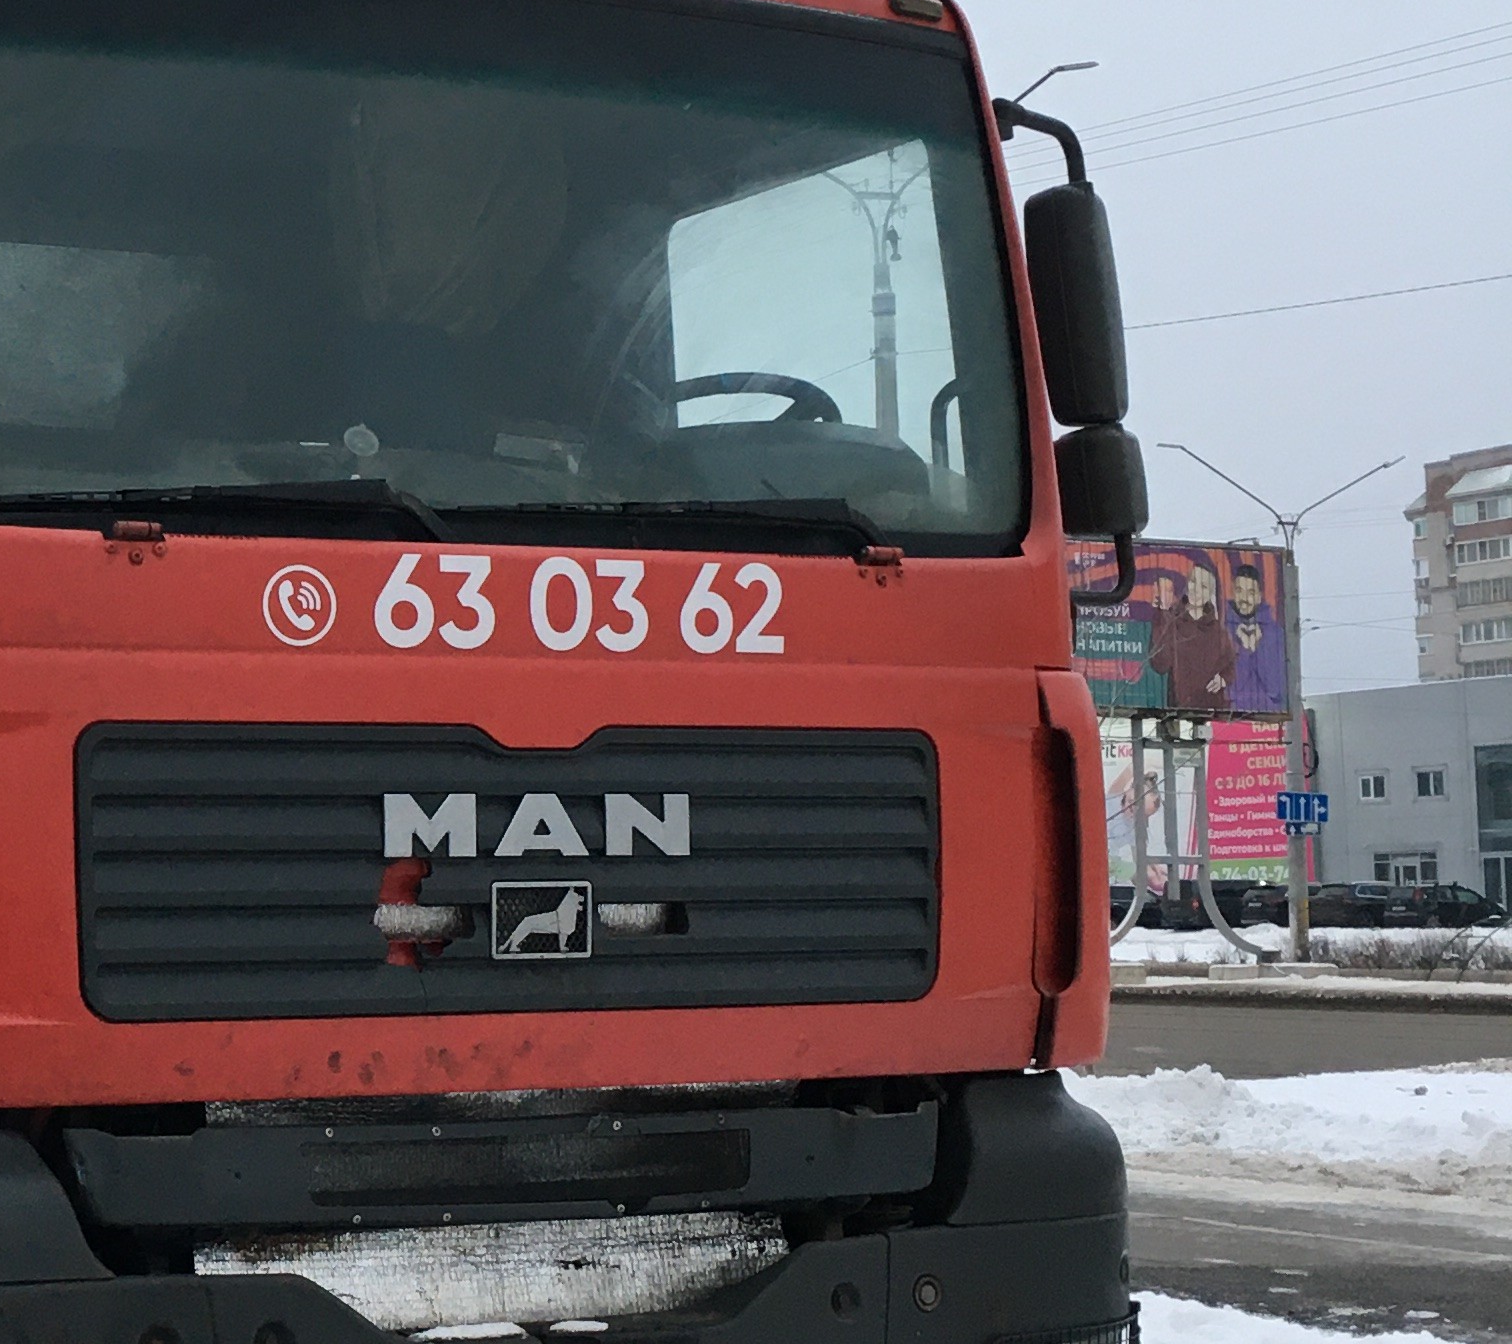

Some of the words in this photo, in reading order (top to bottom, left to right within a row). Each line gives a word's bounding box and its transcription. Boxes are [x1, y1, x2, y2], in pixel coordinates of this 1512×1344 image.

[374, 553, 496, 650] 63
[529, 556, 649, 653] 03
[680, 562, 785, 654] 62
[384, 793, 691, 858] MAN
